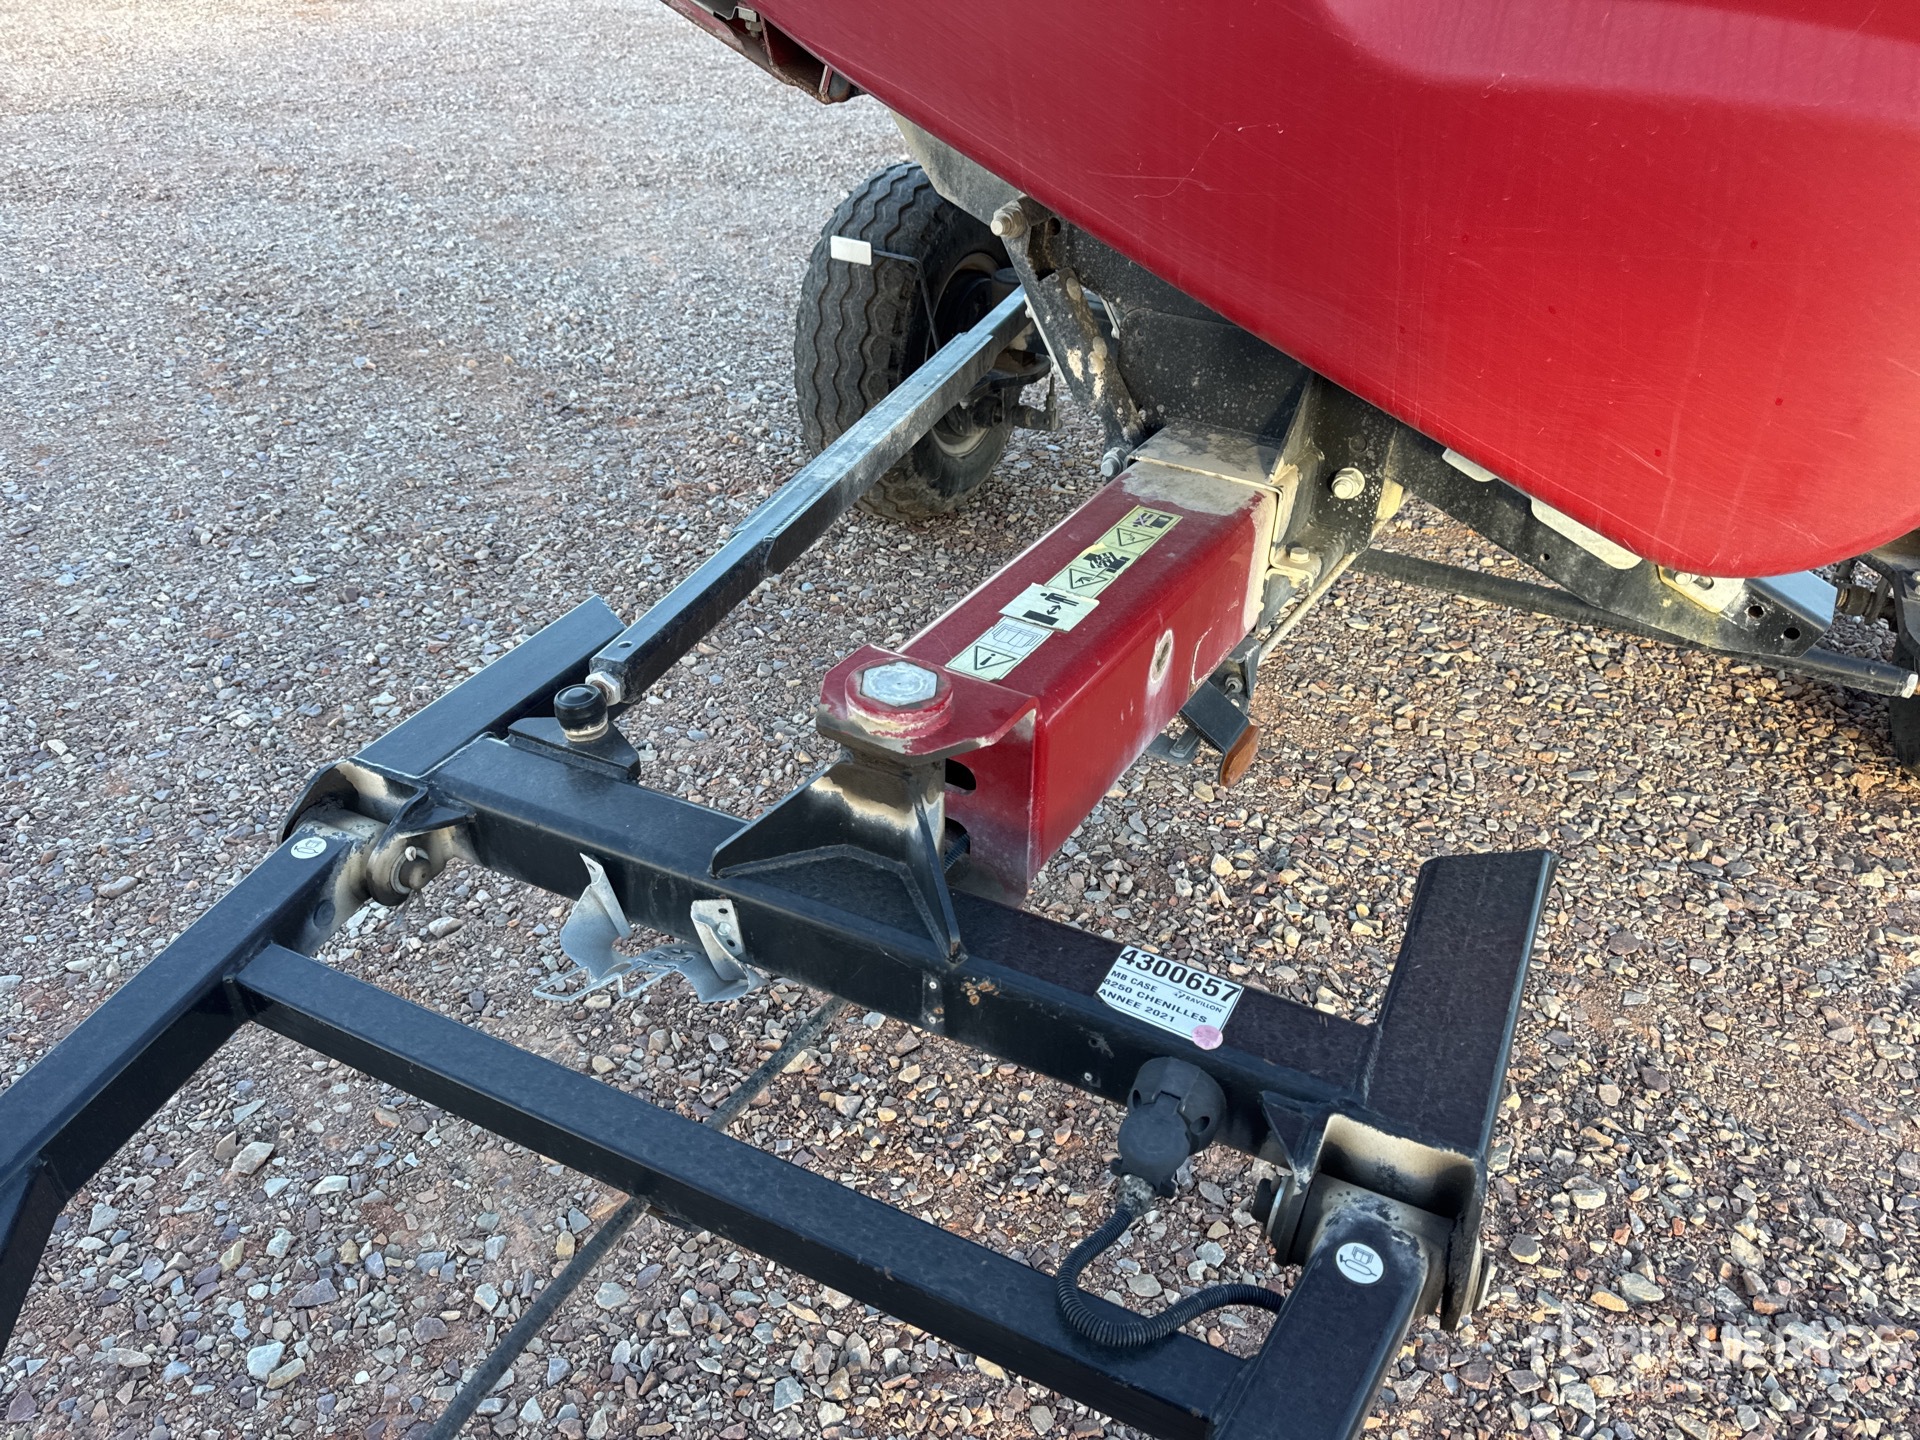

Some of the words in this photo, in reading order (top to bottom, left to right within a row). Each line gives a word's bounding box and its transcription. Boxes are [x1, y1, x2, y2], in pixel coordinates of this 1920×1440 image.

[1120, 949, 1240, 1003] 4300657
[1130, 977, 1158, 993] CASE
[1099, 988, 1142, 1010] ANNEE
[1144, 1006, 1175, 1023] 2021
[1103, 978, 1133, 994] 8250
[1136, 991, 1208, 1023] CHENILLES
[1185, 994, 1222, 1013] RAVILLON
